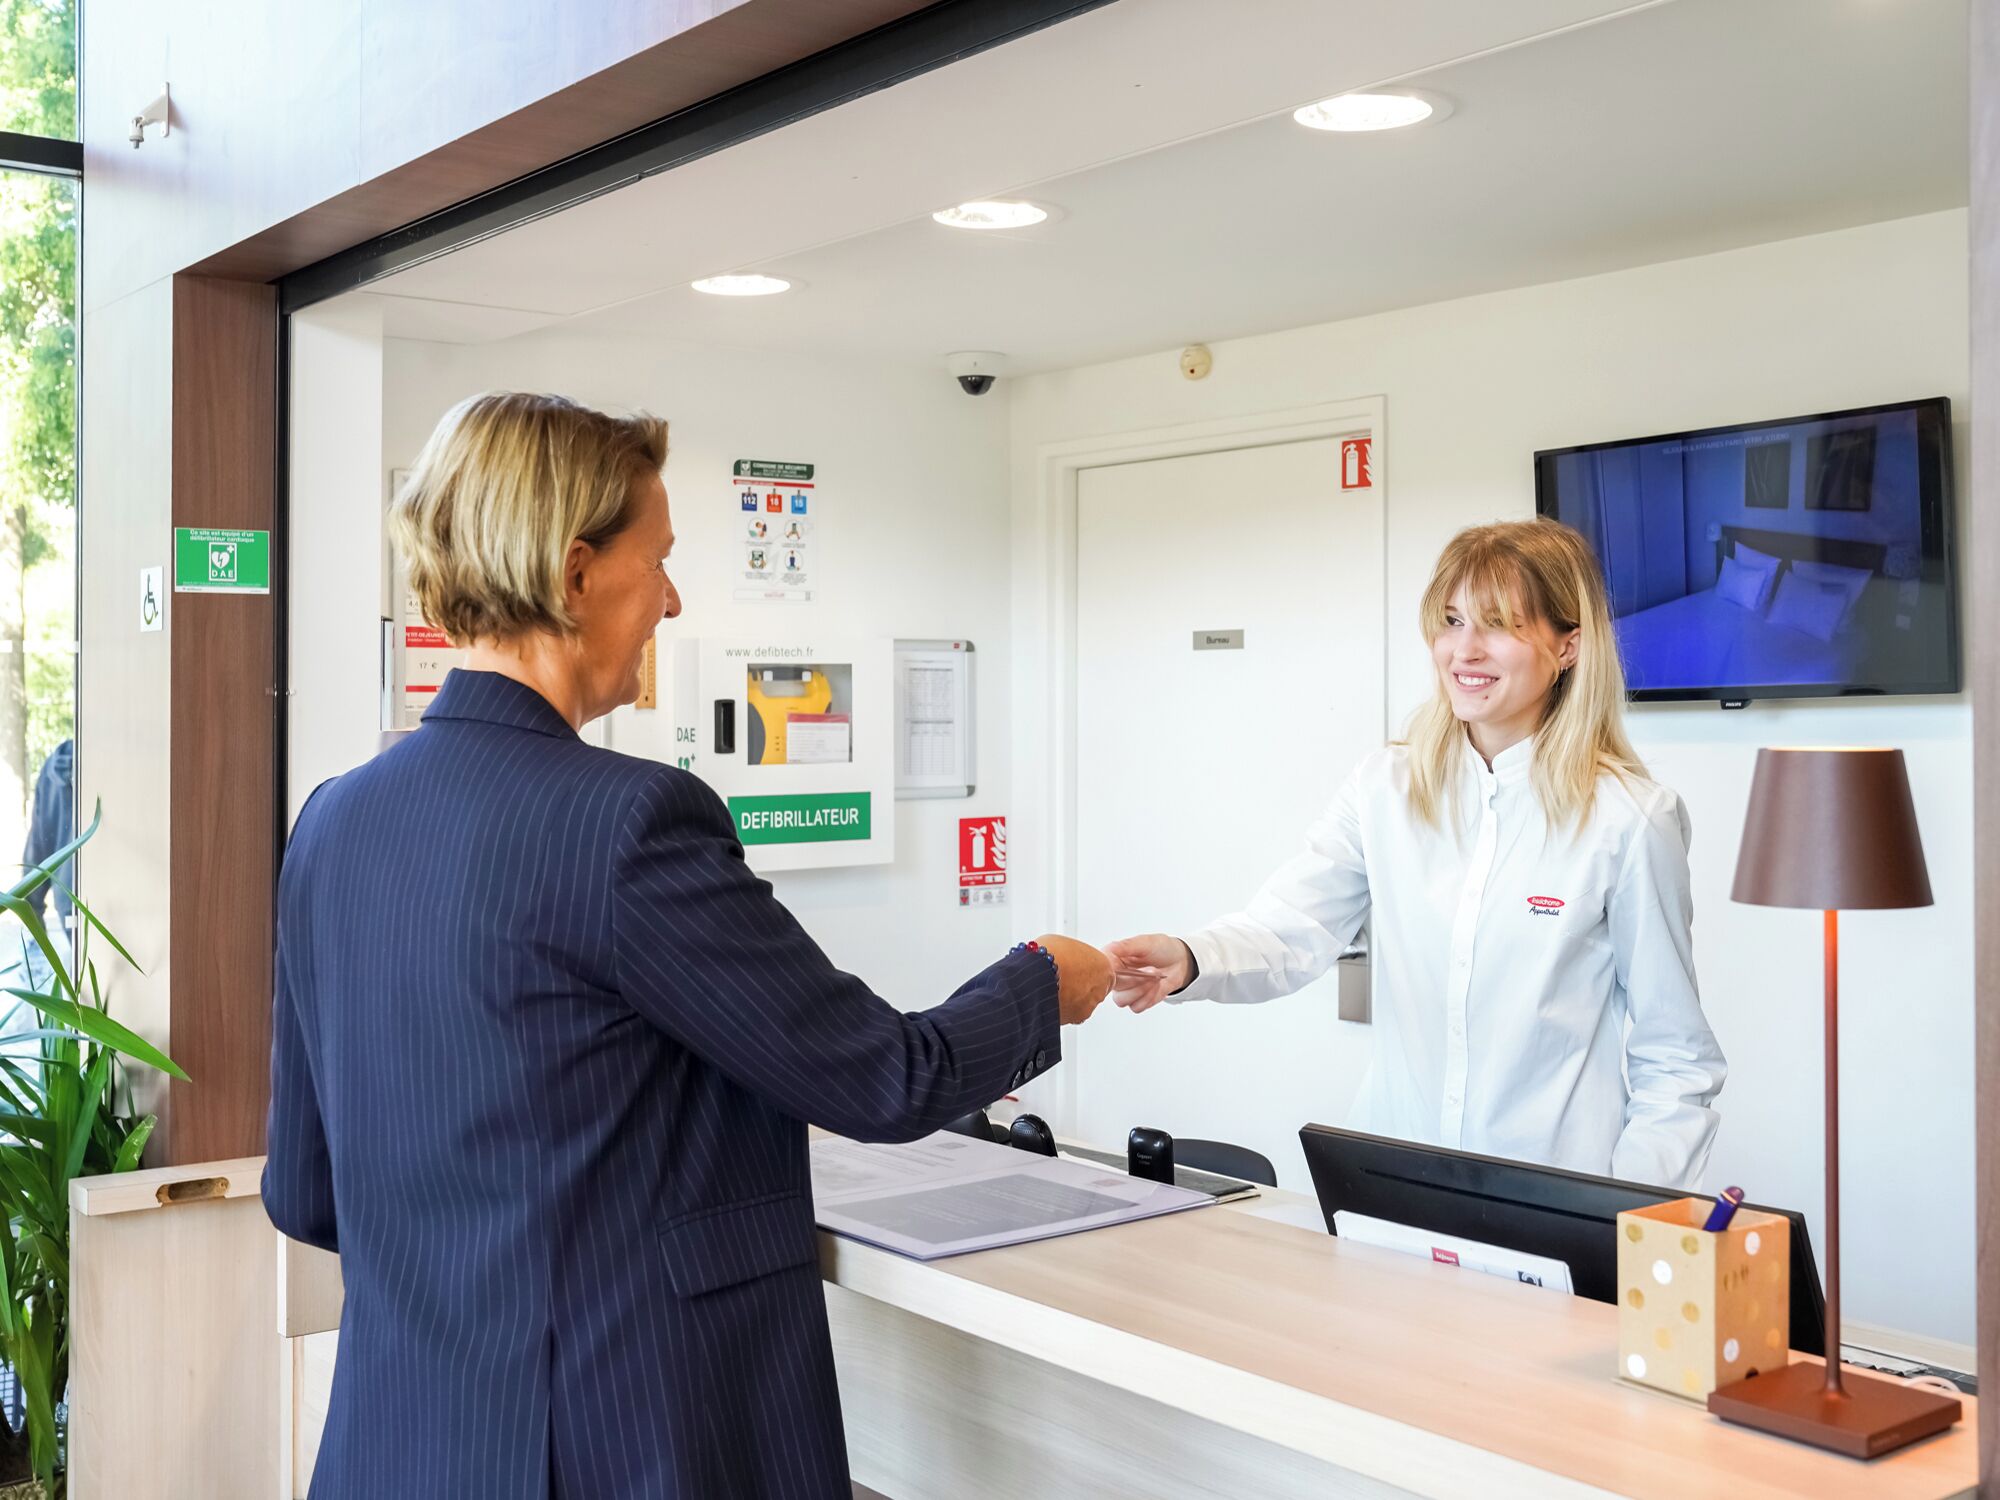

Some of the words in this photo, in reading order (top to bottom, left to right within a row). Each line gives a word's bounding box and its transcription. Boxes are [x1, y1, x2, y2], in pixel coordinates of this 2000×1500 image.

[743, 495, 756, 505] 112
[725, 646, 814, 658] www.defibtech.fr
[676, 727, 696, 743] DAE
[741, 807, 859, 829] DEFIBRILLATEUR
